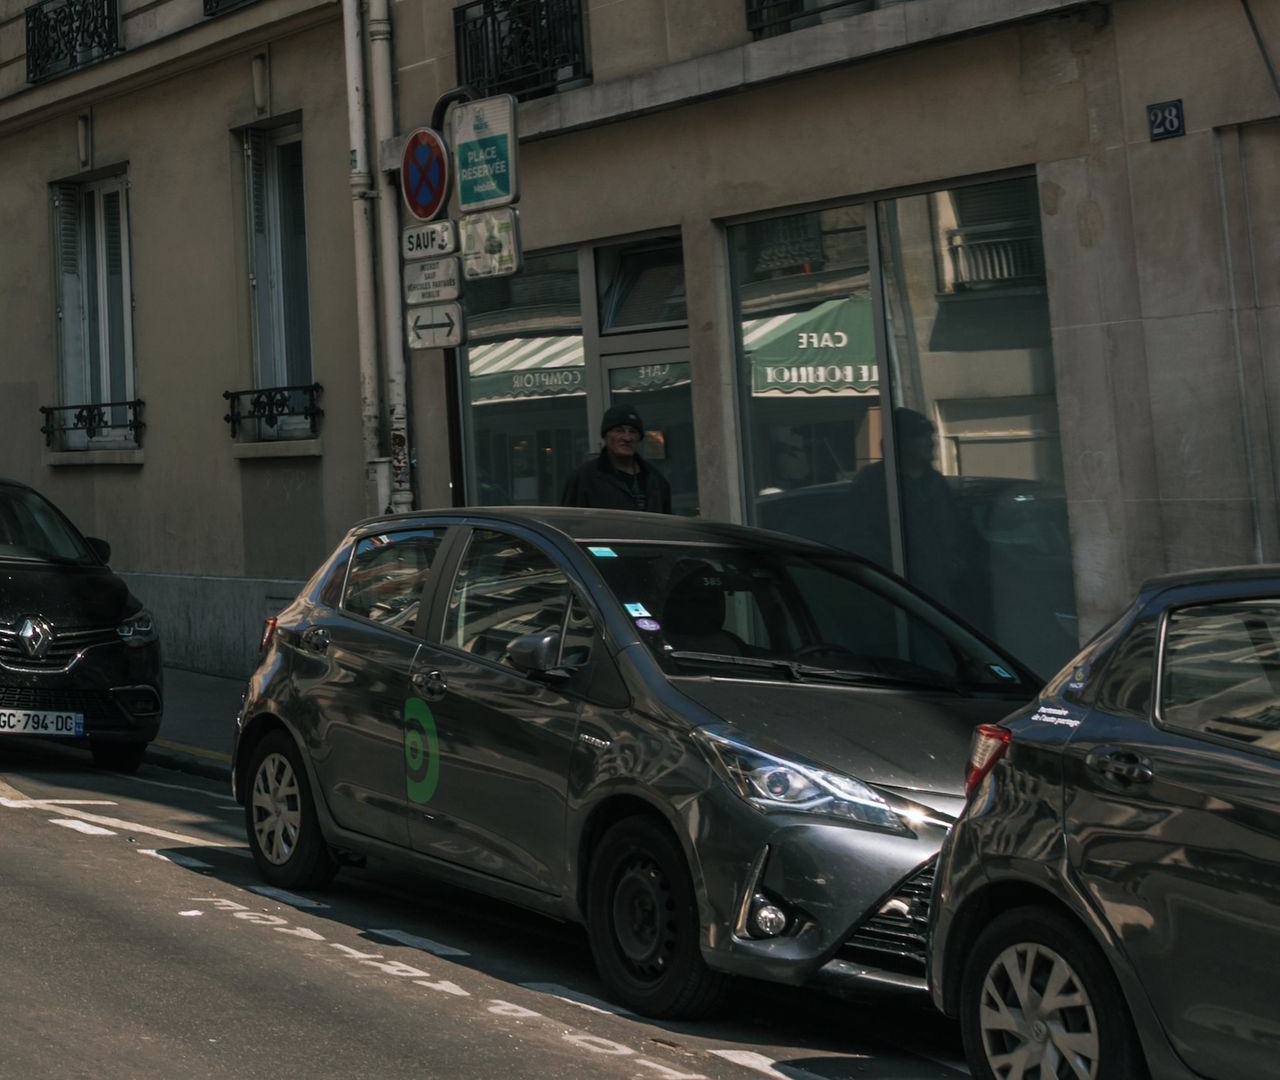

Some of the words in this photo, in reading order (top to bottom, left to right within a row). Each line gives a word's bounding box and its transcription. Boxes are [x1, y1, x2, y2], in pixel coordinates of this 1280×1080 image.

[1150, 106, 1179, 135] 28
[467, 146, 497, 163] PLACE
[407, 230, 436, 251] SAUF
